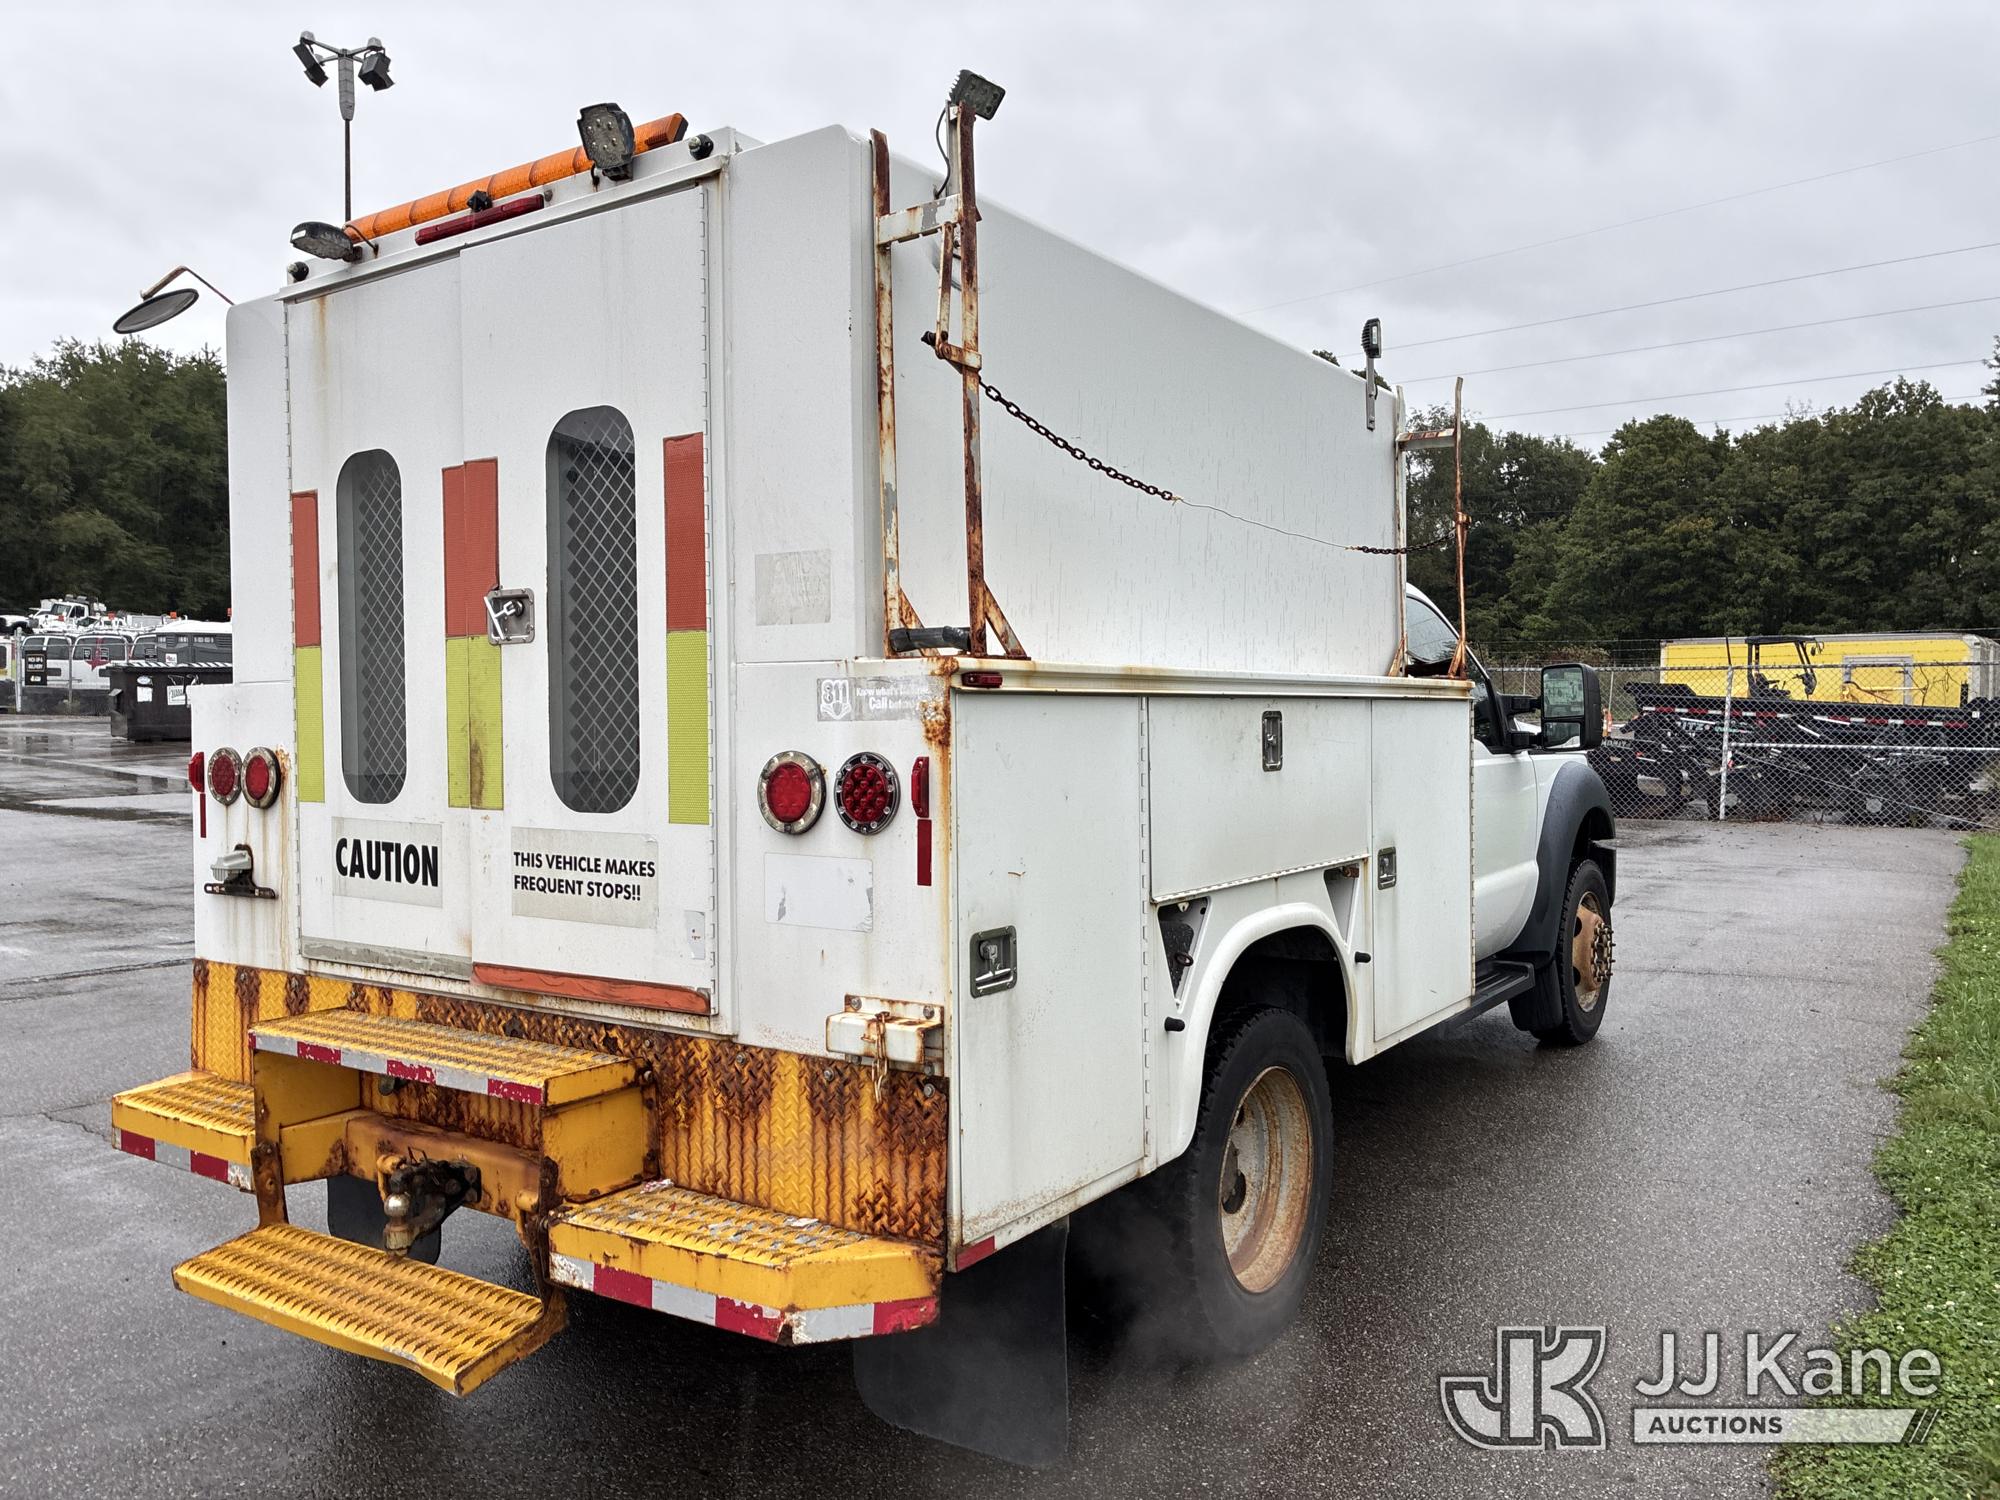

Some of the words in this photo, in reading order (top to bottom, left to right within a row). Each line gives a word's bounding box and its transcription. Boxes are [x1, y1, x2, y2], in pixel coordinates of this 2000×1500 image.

[821, 679, 850, 703] 811
[856, 687, 875, 697] Know
[869, 696, 888, 710] Call
[336, 837, 439, 888] CAUTION
[513, 851, 543, 869] THIS
[545, 854, 601, 873] VEHICLE
[605, 859, 656, 878] MAKES
[514, 875, 584, 896] FREQUENT
[586, 881, 641, 901] STOPS!!
